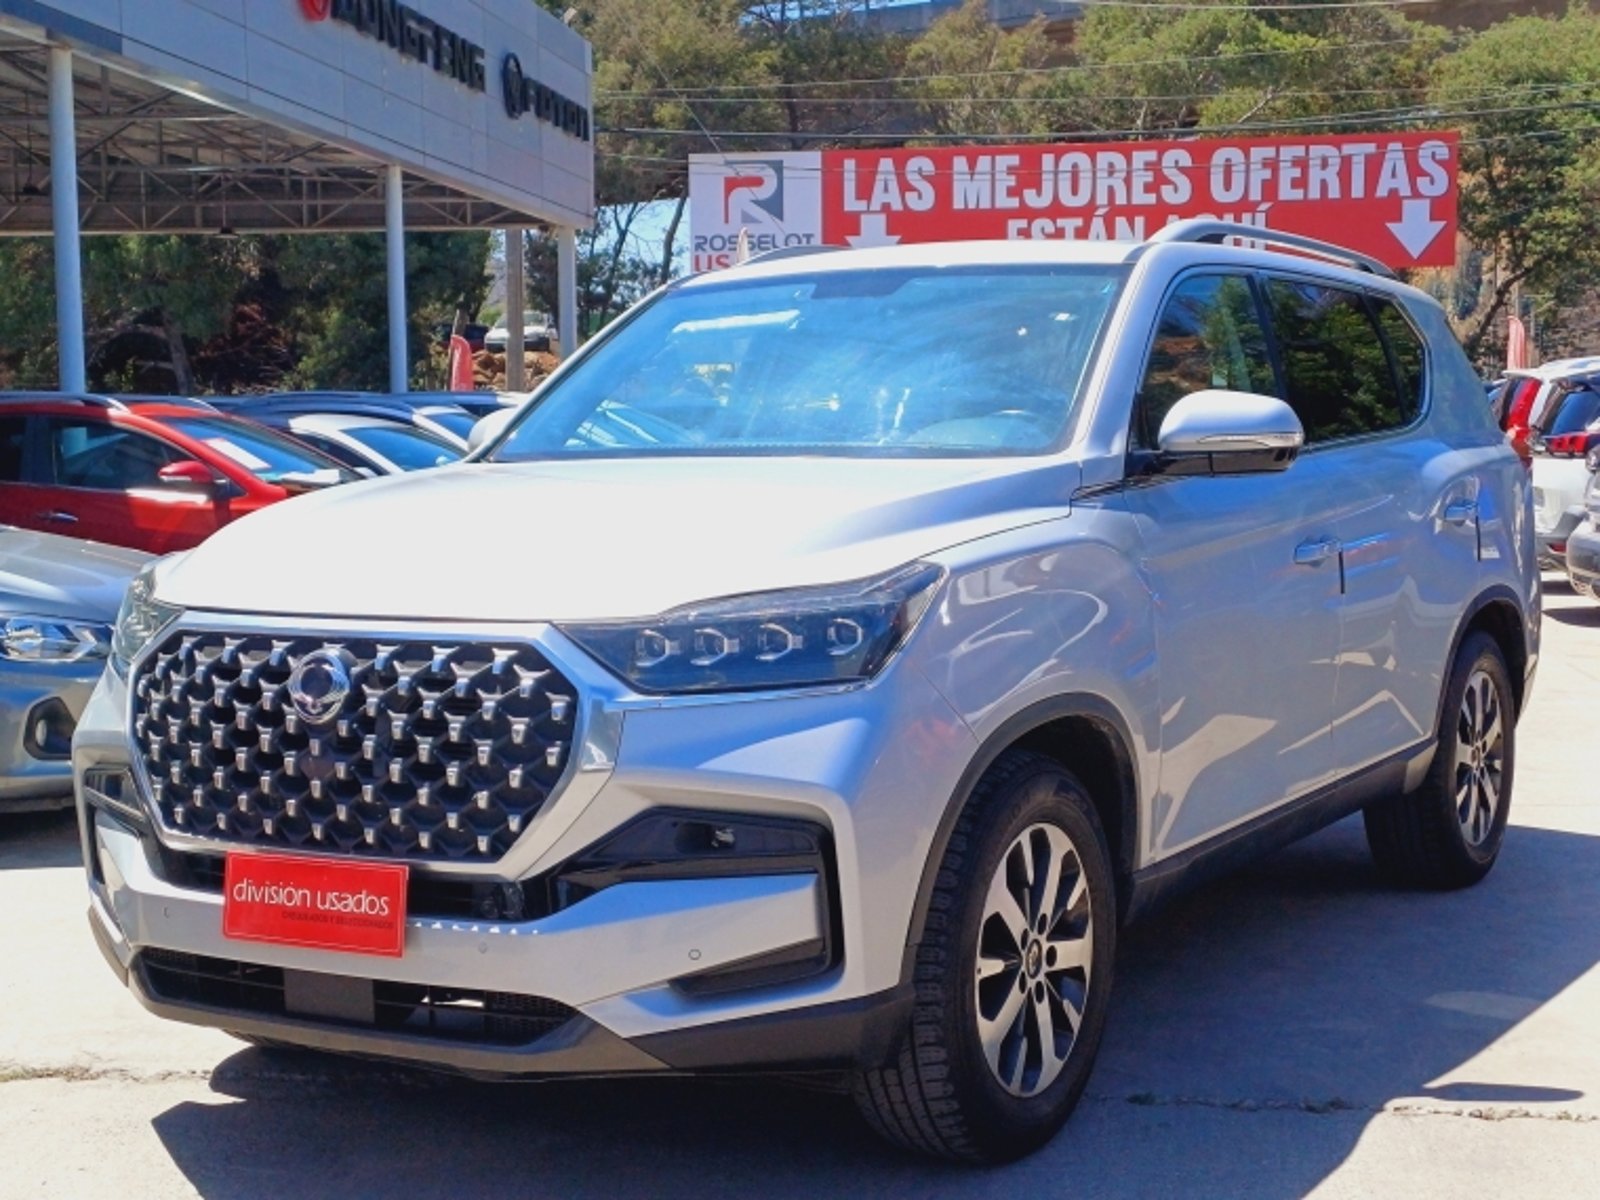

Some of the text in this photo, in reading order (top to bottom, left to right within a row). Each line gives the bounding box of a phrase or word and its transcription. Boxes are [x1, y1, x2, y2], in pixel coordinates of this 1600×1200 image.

[843, 140, 1451, 212] LAS MEJORES OFERTAS
[316, 890, 390, 916] usados
